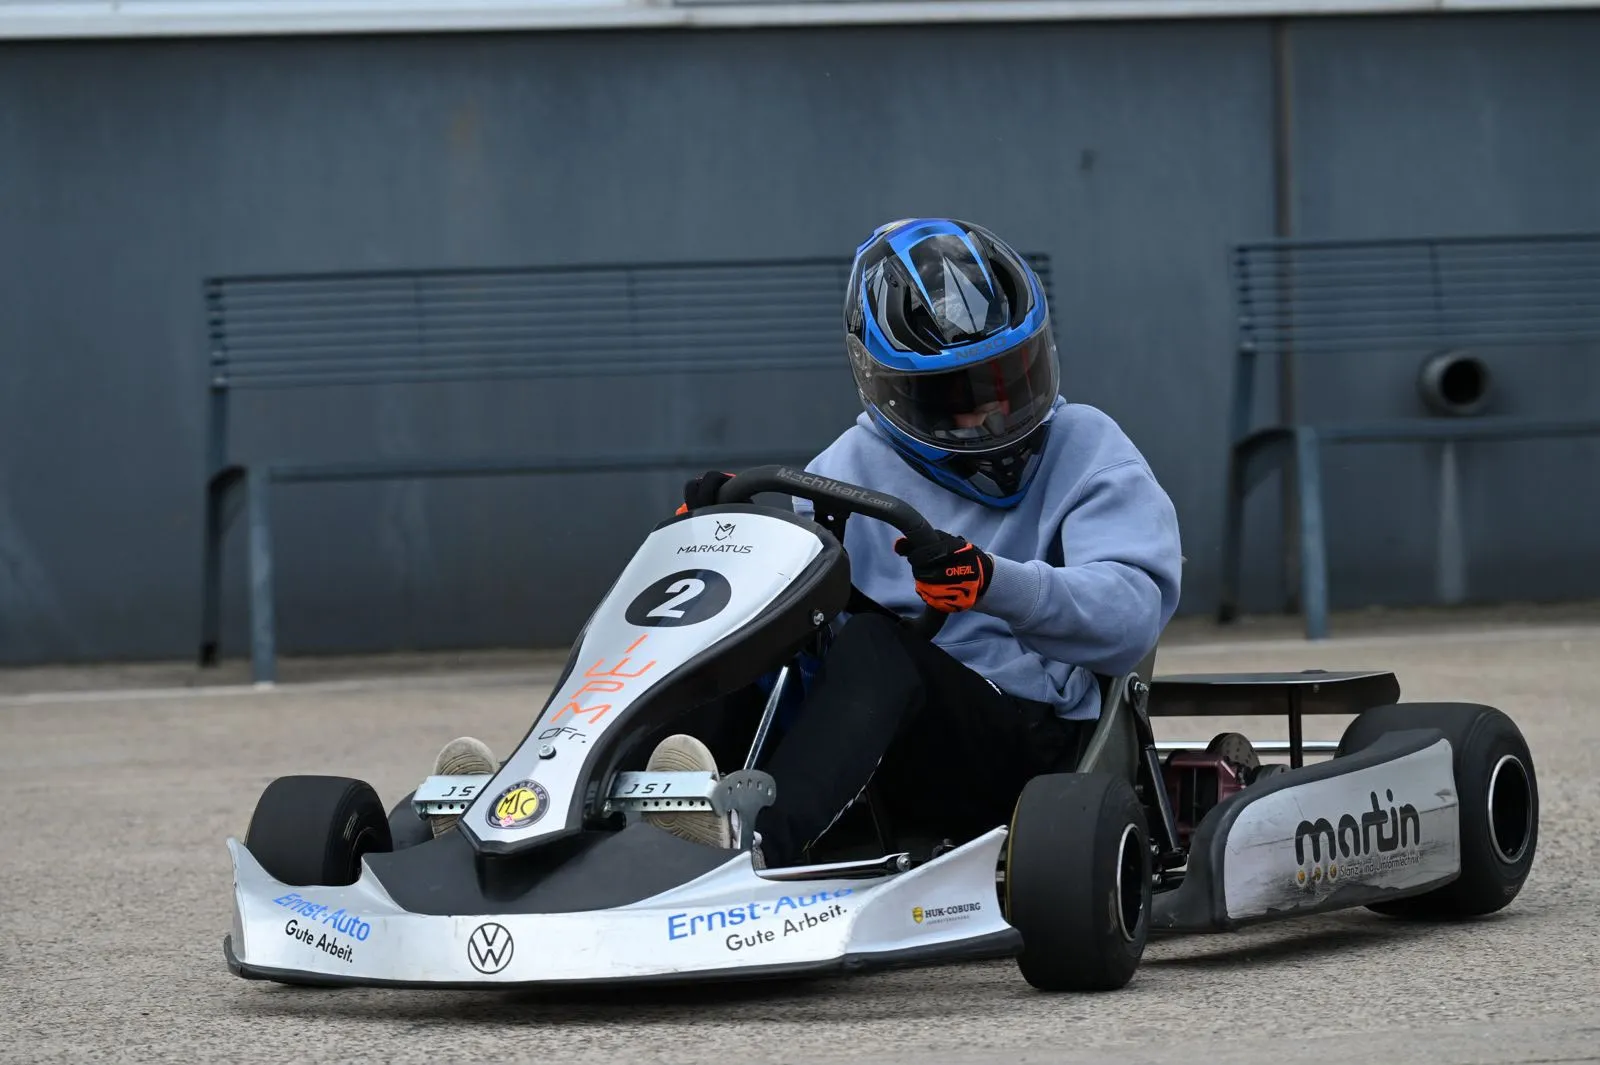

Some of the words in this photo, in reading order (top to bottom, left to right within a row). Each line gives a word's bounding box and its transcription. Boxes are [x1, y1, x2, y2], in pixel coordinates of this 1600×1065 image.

[955, 336, 1007, 360] NEXO
[677, 543, 754, 555] MARKATUS
[645, 577, 706, 619] 2
[498, 789, 535, 816] MSC
[624, 783, 672, 795] JS1
[1294, 788, 1421, 866] martin
[272, 892, 371, 942] Ernst-Auto
[667, 887, 855, 941] Ernst-Auto
[725, 930, 775, 951] Gute
[783, 904, 848, 937] Arbeit.
[925, 902, 981, 918] HUK-COBURG
[285, 919, 315, 945] Gute
[315, 934, 353, 963] Arbeit.
